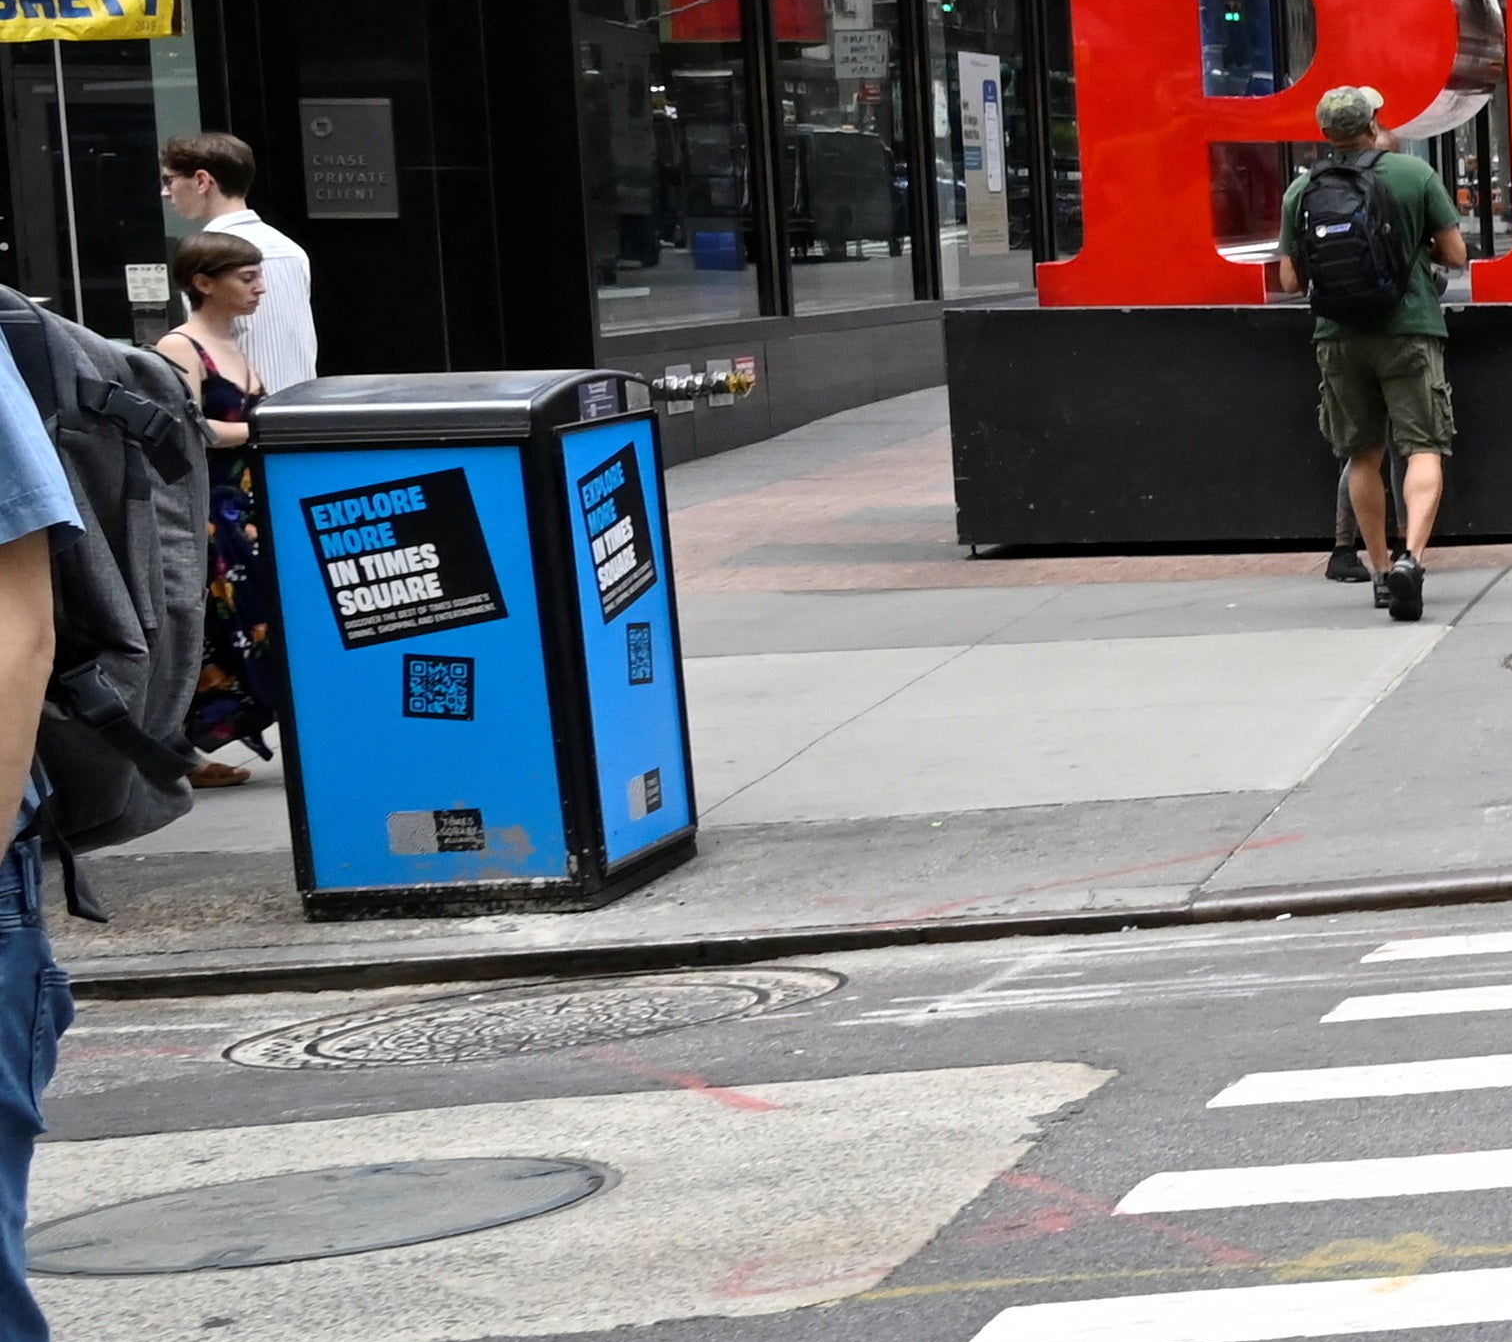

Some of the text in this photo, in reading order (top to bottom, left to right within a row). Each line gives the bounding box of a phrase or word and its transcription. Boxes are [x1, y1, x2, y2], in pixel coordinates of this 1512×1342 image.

[312, 154, 367, 167] CHASE
[314, 171, 388, 184] PRIVATE
[316, 187, 374, 200] CLIENT
[582, 460, 625, 510] EXPLORE
[310, 485, 427, 531] EXPLORE
[319, 521, 397, 559] MORE
[327, 543, 440, 588] IN TIMES
[597, 542, 637, 592] SQUARE
[336, 572, 444, 616] SQUARE
